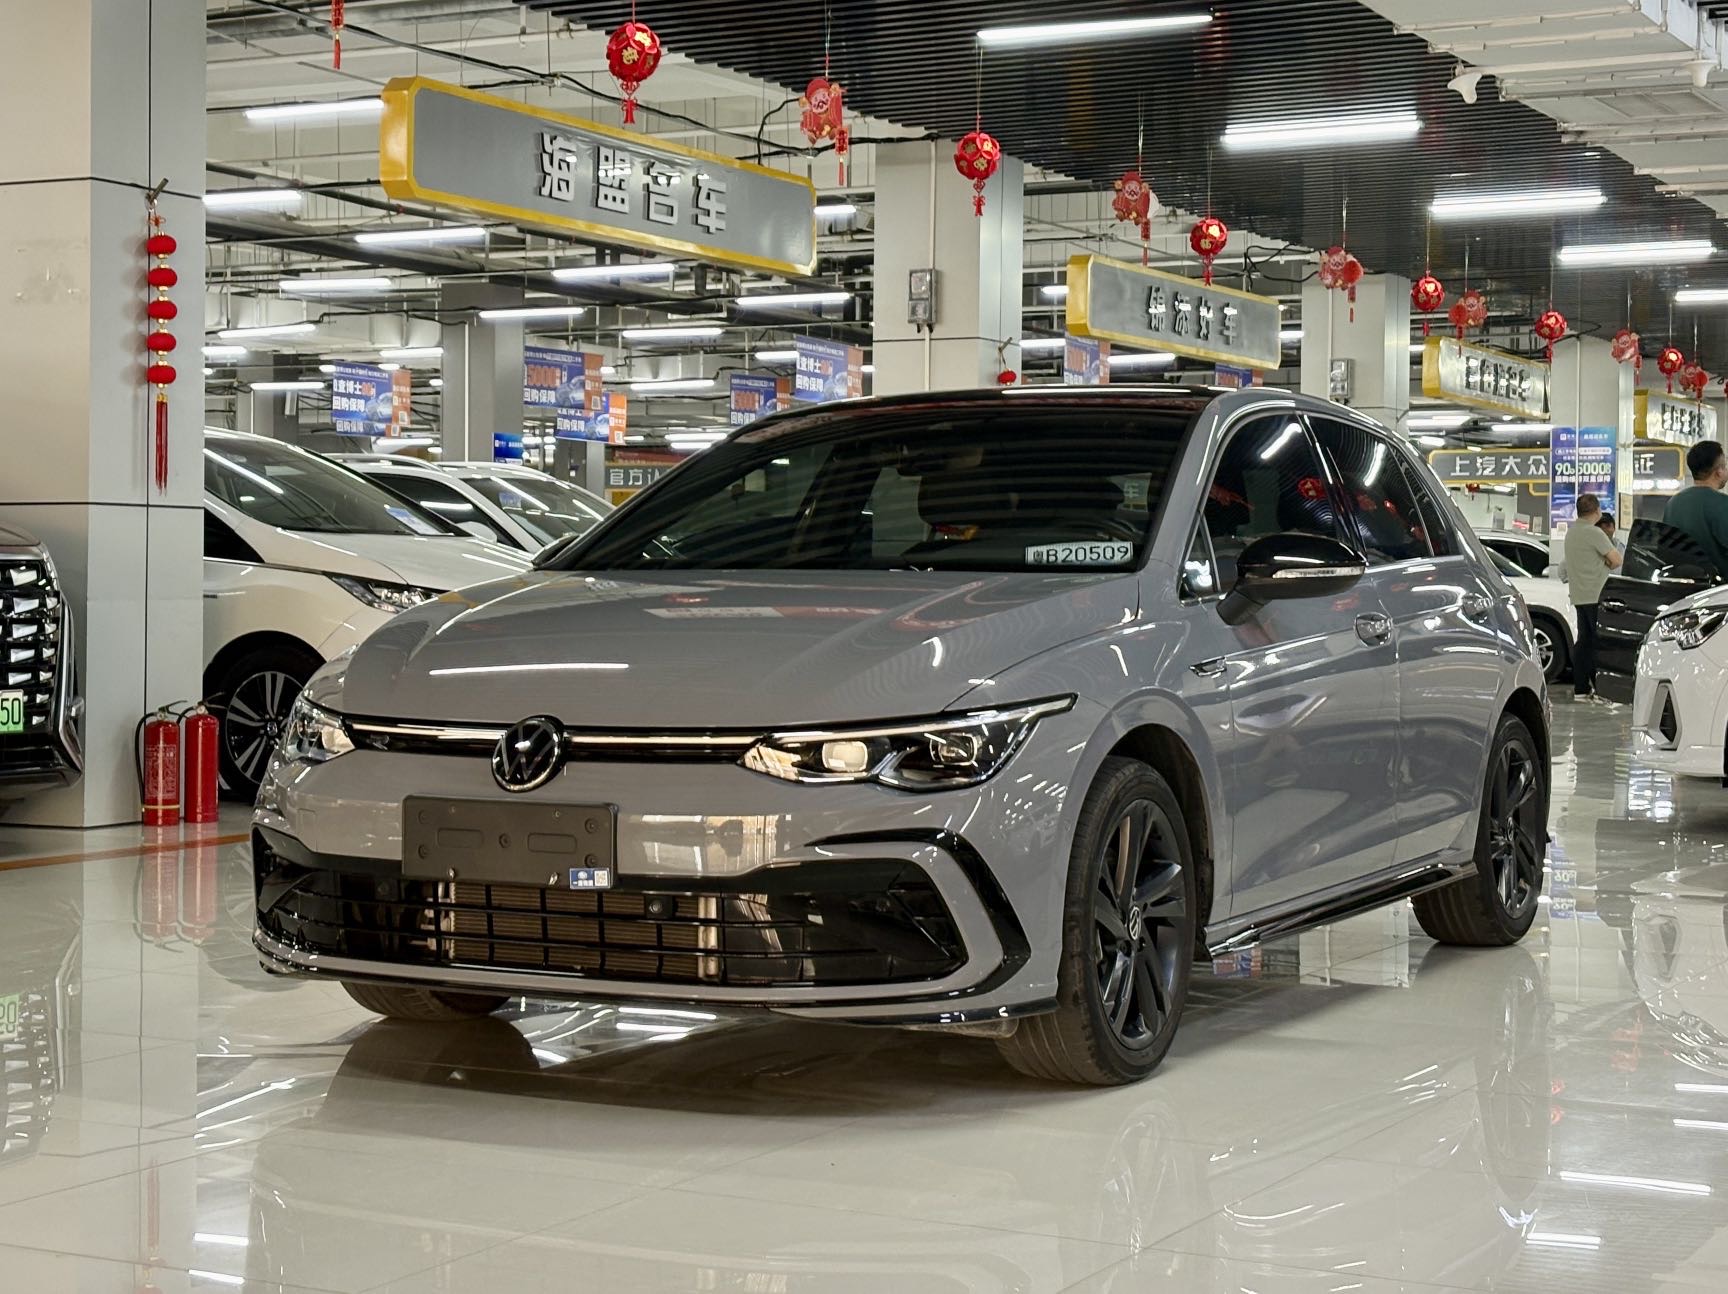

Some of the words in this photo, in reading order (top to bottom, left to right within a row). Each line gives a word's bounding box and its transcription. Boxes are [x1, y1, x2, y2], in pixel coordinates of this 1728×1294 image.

[1450, 455, 1548, 477] 上汽大众
[0, 697, 21, 726] 50
